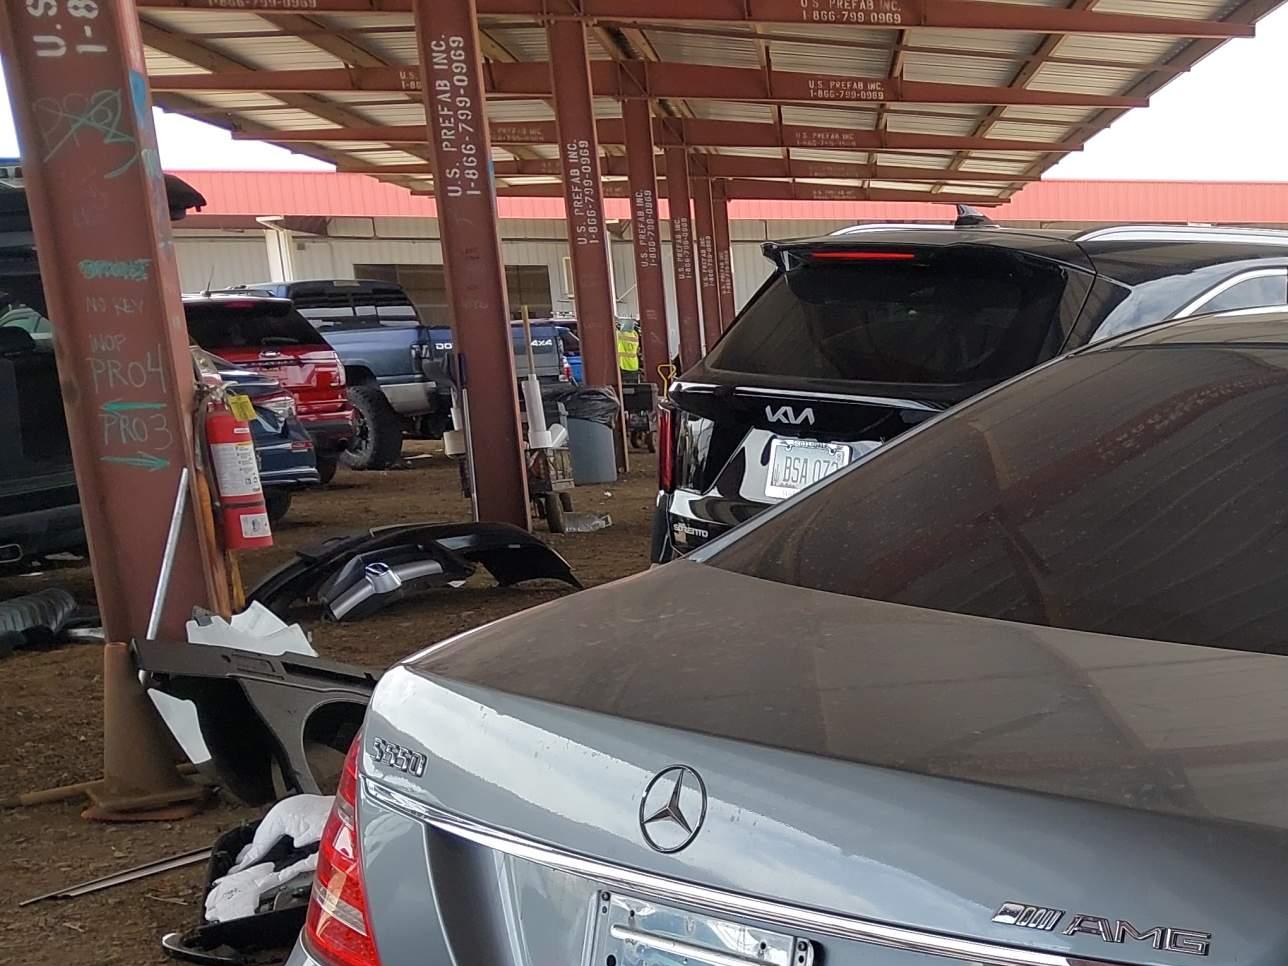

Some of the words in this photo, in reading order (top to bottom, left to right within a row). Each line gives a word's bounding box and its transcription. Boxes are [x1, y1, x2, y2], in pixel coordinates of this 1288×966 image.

[431, 34, 449, 69] INC.
[829, 81, 864, 90] PREFAB
[867, 82, 884, 91] INC.
[435, 80, 457, 151] PREFAB
[450, 36, 481, 195] 1-866-799-0969
[567, 139, 579, 163] INC.
[447, 162, 463, 197] U.S.
[569, 169, 586, 216] PREFAB
[765, 405, 815, 425] KIA
[783, 455, 808, 484] BSA
[1063, 913, 1212, 956] AMG
